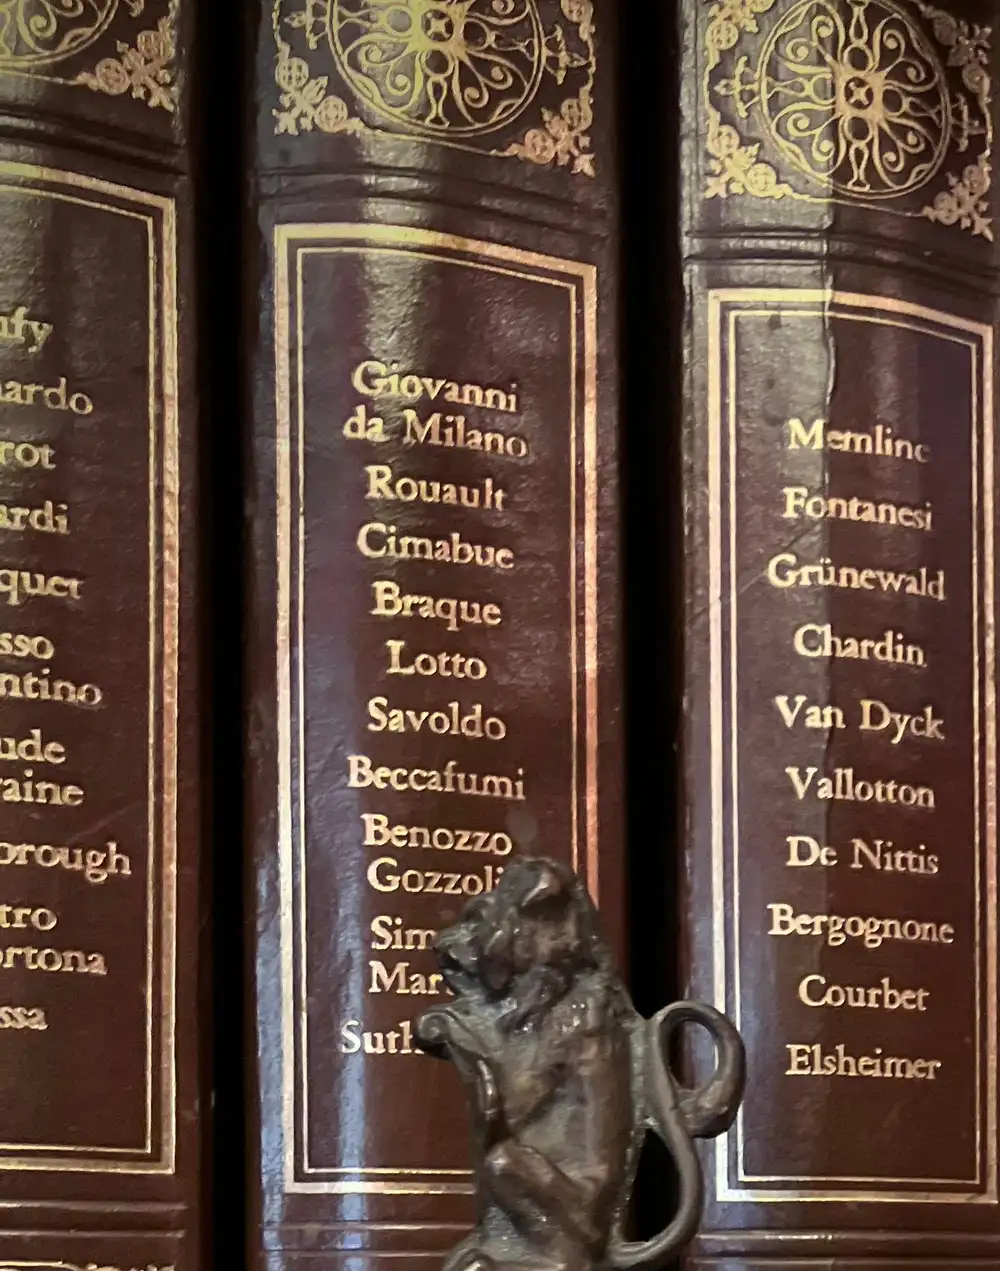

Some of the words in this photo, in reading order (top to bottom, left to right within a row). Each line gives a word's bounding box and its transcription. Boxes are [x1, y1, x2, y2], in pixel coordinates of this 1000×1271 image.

[0, 377, 94, 415] ardo
[352, 360, 517, 413] Giovanni
[342, 405, 386, 443] da
[403, 409, 528, 458] Milano
[365, 465, 508, 511] Rouault
[781, 486, 932, 531] Fontanesi
[357, 522, 515, 569] Cimabue
[767, 553, 945, 601] Grünewald
[368, 580, 503, 631] Braque
[385, 639, 488, 680] Lotto
[794, 623, 927, 667] Chardin
[367, 696, 506, 740] Savoldo
[774, 695, 846, 729] Van
[859, 699, 945, 745] Dyck
[0, 769, 84, 806] aine
[346, 754, 526, 800] Beccafumi
[785, 766, 936, 808] Vallotton
[360, 813, 513, 856] Benozzo
[785, 835, 838, 866] De
[851, 838, 939, 875] Nittis
[766, 903, 955, 948] Bergognone
[0, 946, 108, 975] rtona
[798, 974, 930, 1012] Courbet
[785, 1043, 942, 1081] Elsheimer
